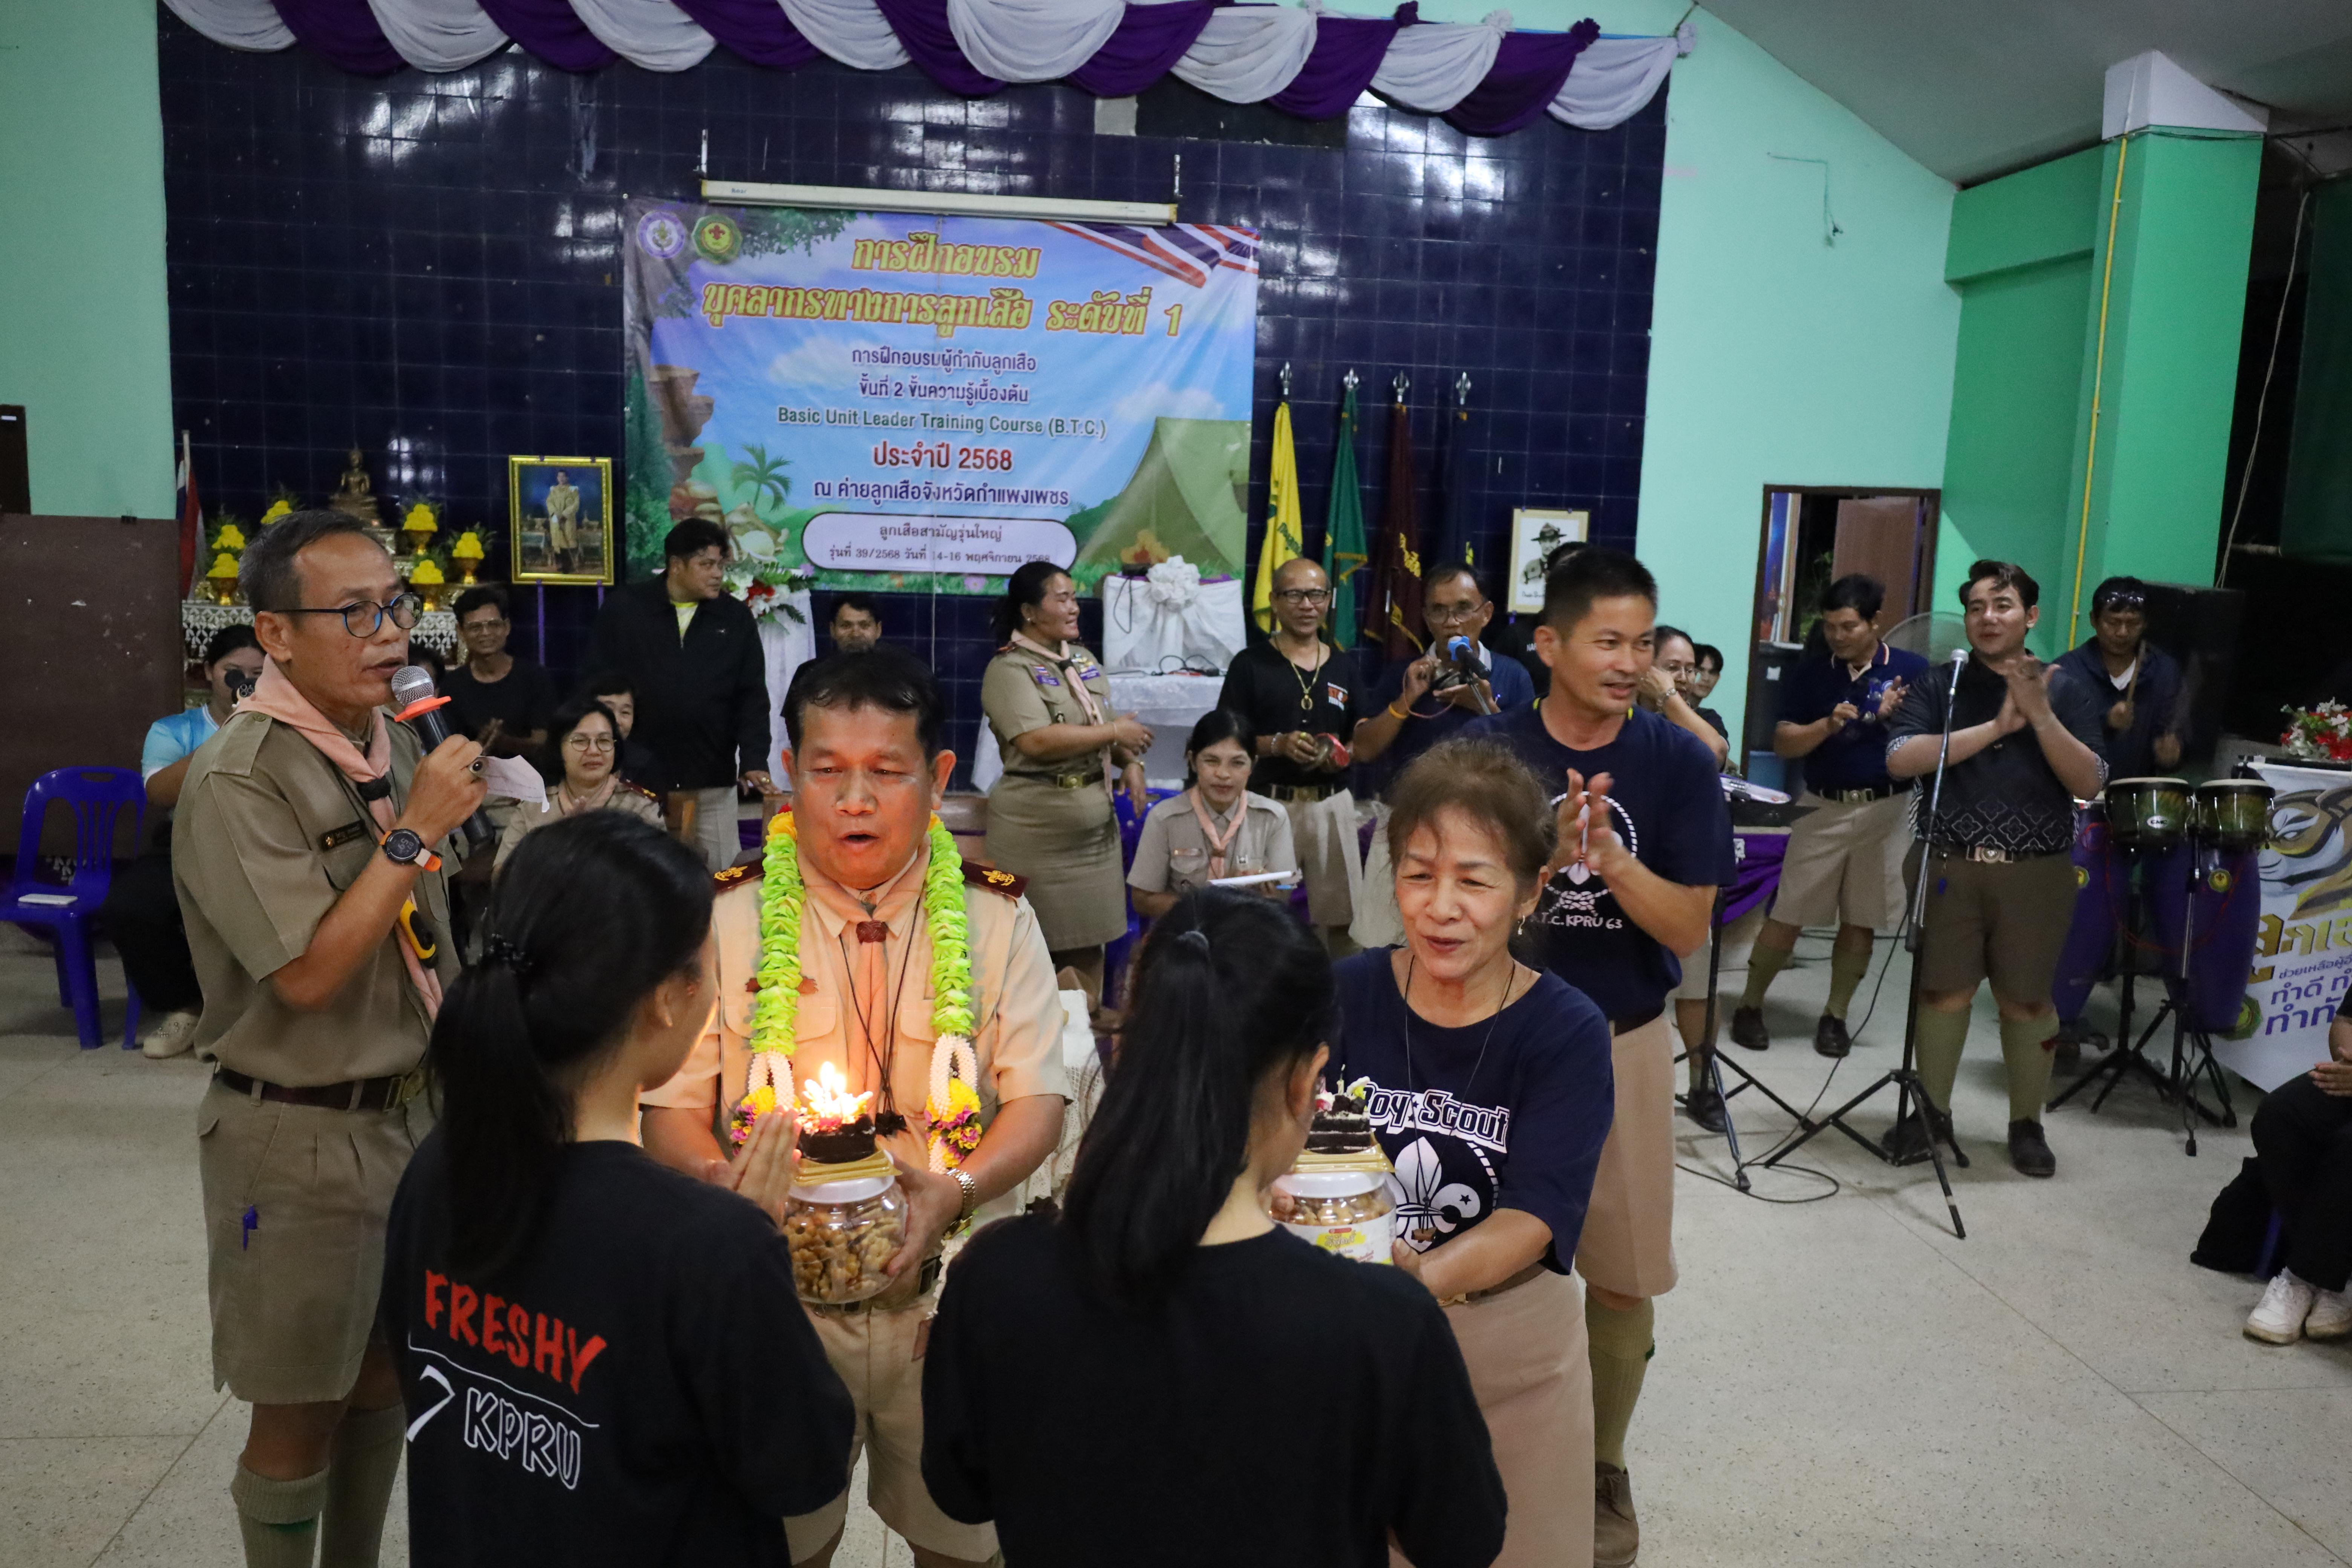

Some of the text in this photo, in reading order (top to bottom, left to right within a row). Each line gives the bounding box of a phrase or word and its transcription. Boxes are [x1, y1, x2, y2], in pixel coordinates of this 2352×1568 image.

[851, 231, 1041, 278] การฝึกอบรม
[702, 283, 1182, 337] บุคลากรทางการลูกเสือ ระดับที่ 1
[852, 345, 1037, 375] การฝึกอบรมผู้กำกับลูกเสือ
[859, 373, 1028, 406] ขั้นที่ 2 ขั้นความรู้เบื้องต้น
[778, 407, 1106, 439] Basic Unit Leader Training Course (B.T.C.)
[874, 440, 1012, 471] ประจำปี 2568
[814, 477, 1069, 505] ณ ค่ายลูกเสือจังหวัดกำแพงเพชร
[879, 522, 1002, 543] ลูกเสือสามัญรุ่นใหญ่
[829, 541, 851, 561] รุ่นที่
[856, 548, 900, 559] 39/2568
[904, 544, 926, 560] วันที่
[965, 551, 1022, 564] พฤศจิกายน
[2271, 975, 2324, 1005] ทำดี
[1419, 1091, 1509, 1146] Scout
[425, 1269, 607, 1394] FRESHY
[464, 1387, 580, 1490] KPRU
